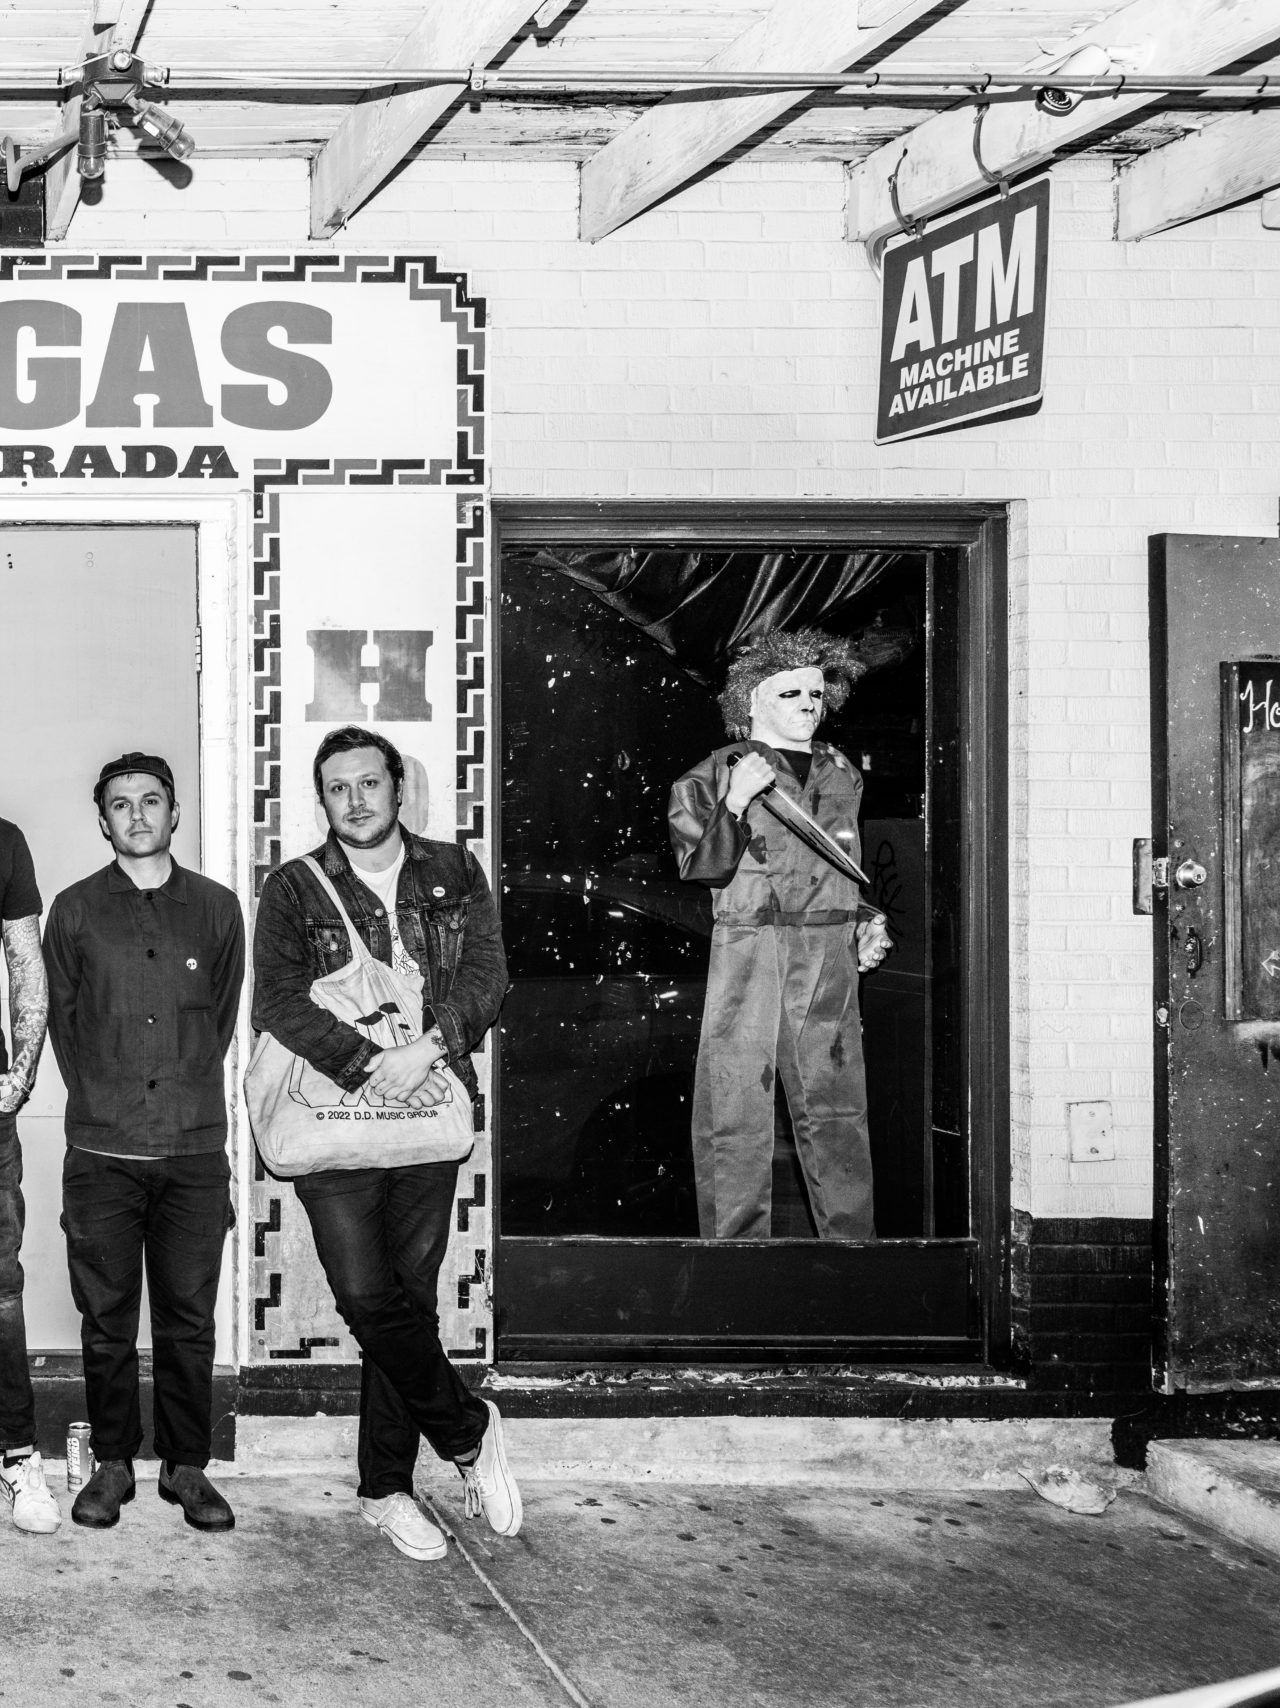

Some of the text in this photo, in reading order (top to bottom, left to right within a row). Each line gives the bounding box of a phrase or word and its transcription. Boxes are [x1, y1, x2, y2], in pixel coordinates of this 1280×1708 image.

[890, 205, 1038, 363] ATM
[888, 353, 1029, 417] AVAILABLE
[899, 328, 1020, 390] MACHINE
[306, 629, 434, 722] H
[327, 1111, 351, 1120] 2022
[354, 1111, 374, 1120] D.D.
[376, 1111, 405, 1120] MUSIC
[407, 1109, 438, 1119] GROUP
